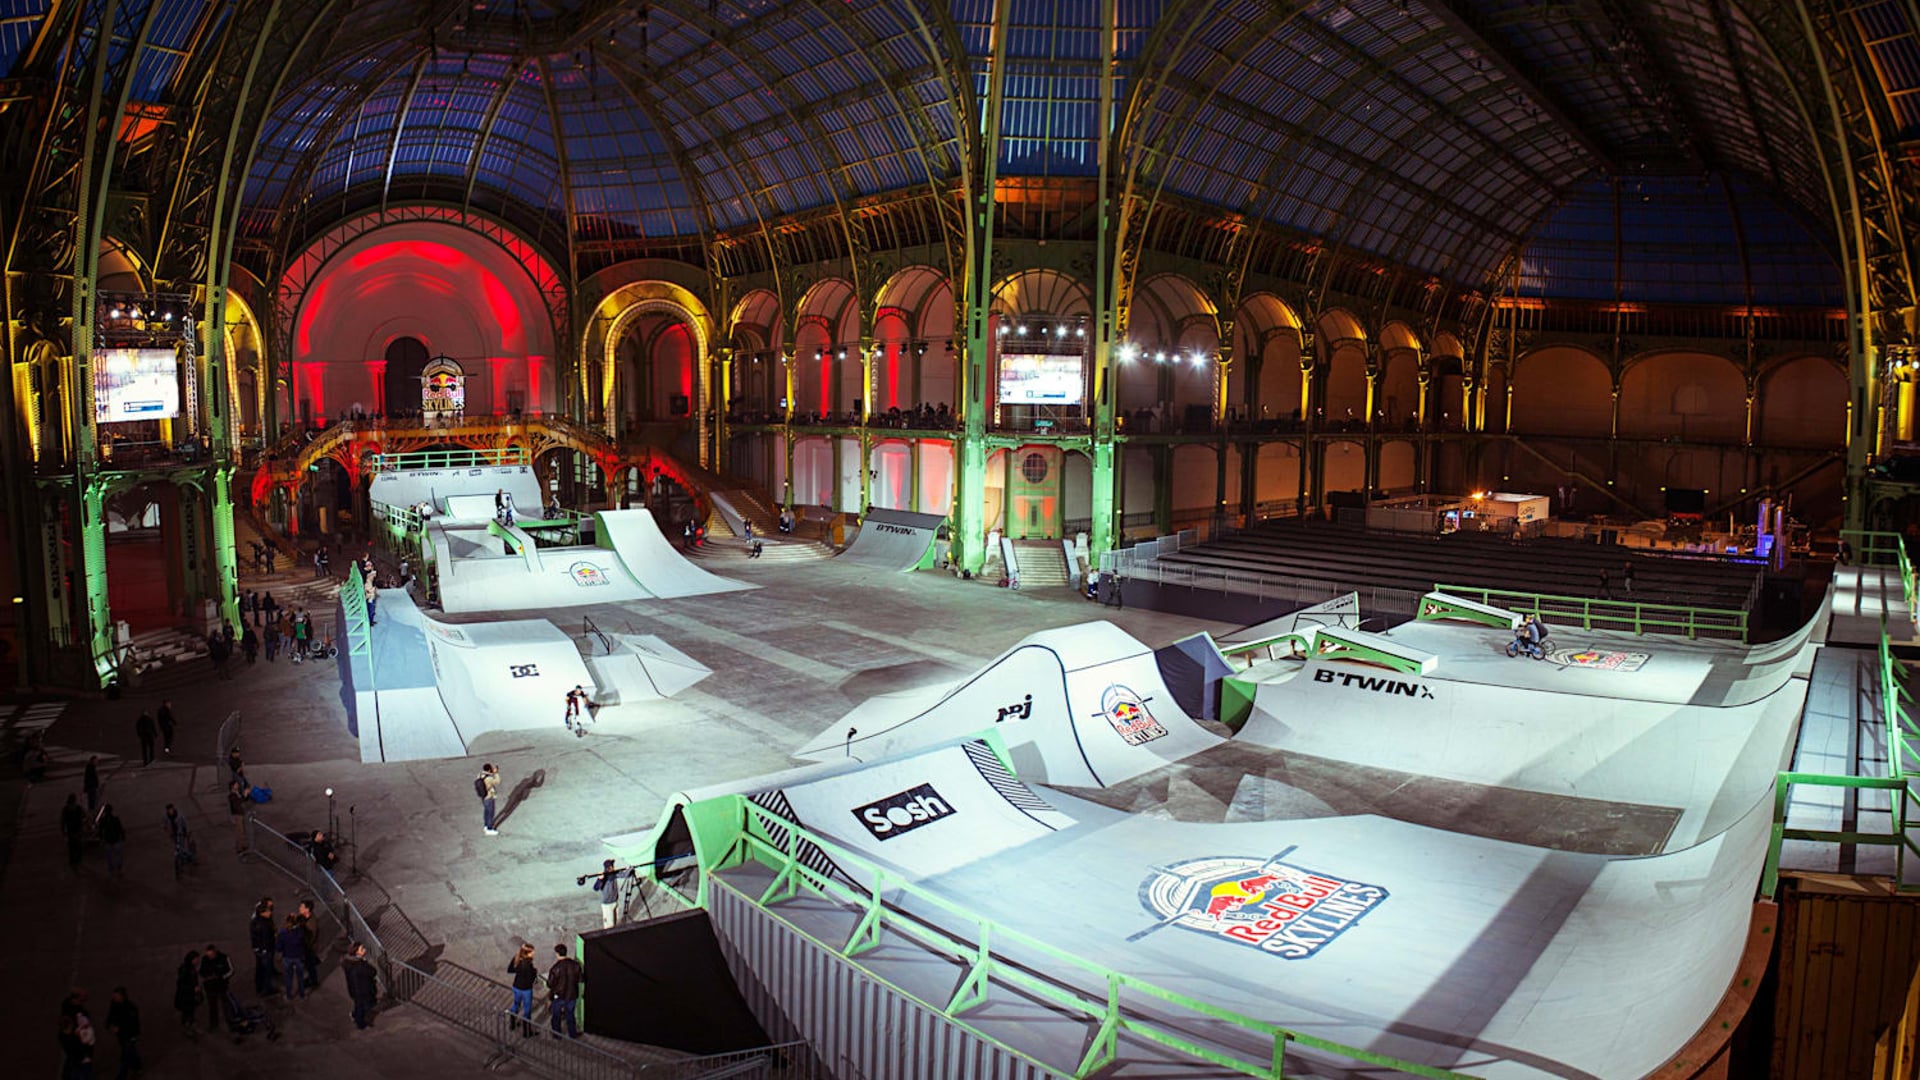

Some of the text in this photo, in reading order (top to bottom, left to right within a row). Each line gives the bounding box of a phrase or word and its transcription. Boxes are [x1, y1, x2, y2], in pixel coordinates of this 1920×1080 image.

[863, 794, 948, 833] Sosh
[1224, 875, 1342, 943] Red Bull
[1261, 882, 1383, 957] SKYLINES
